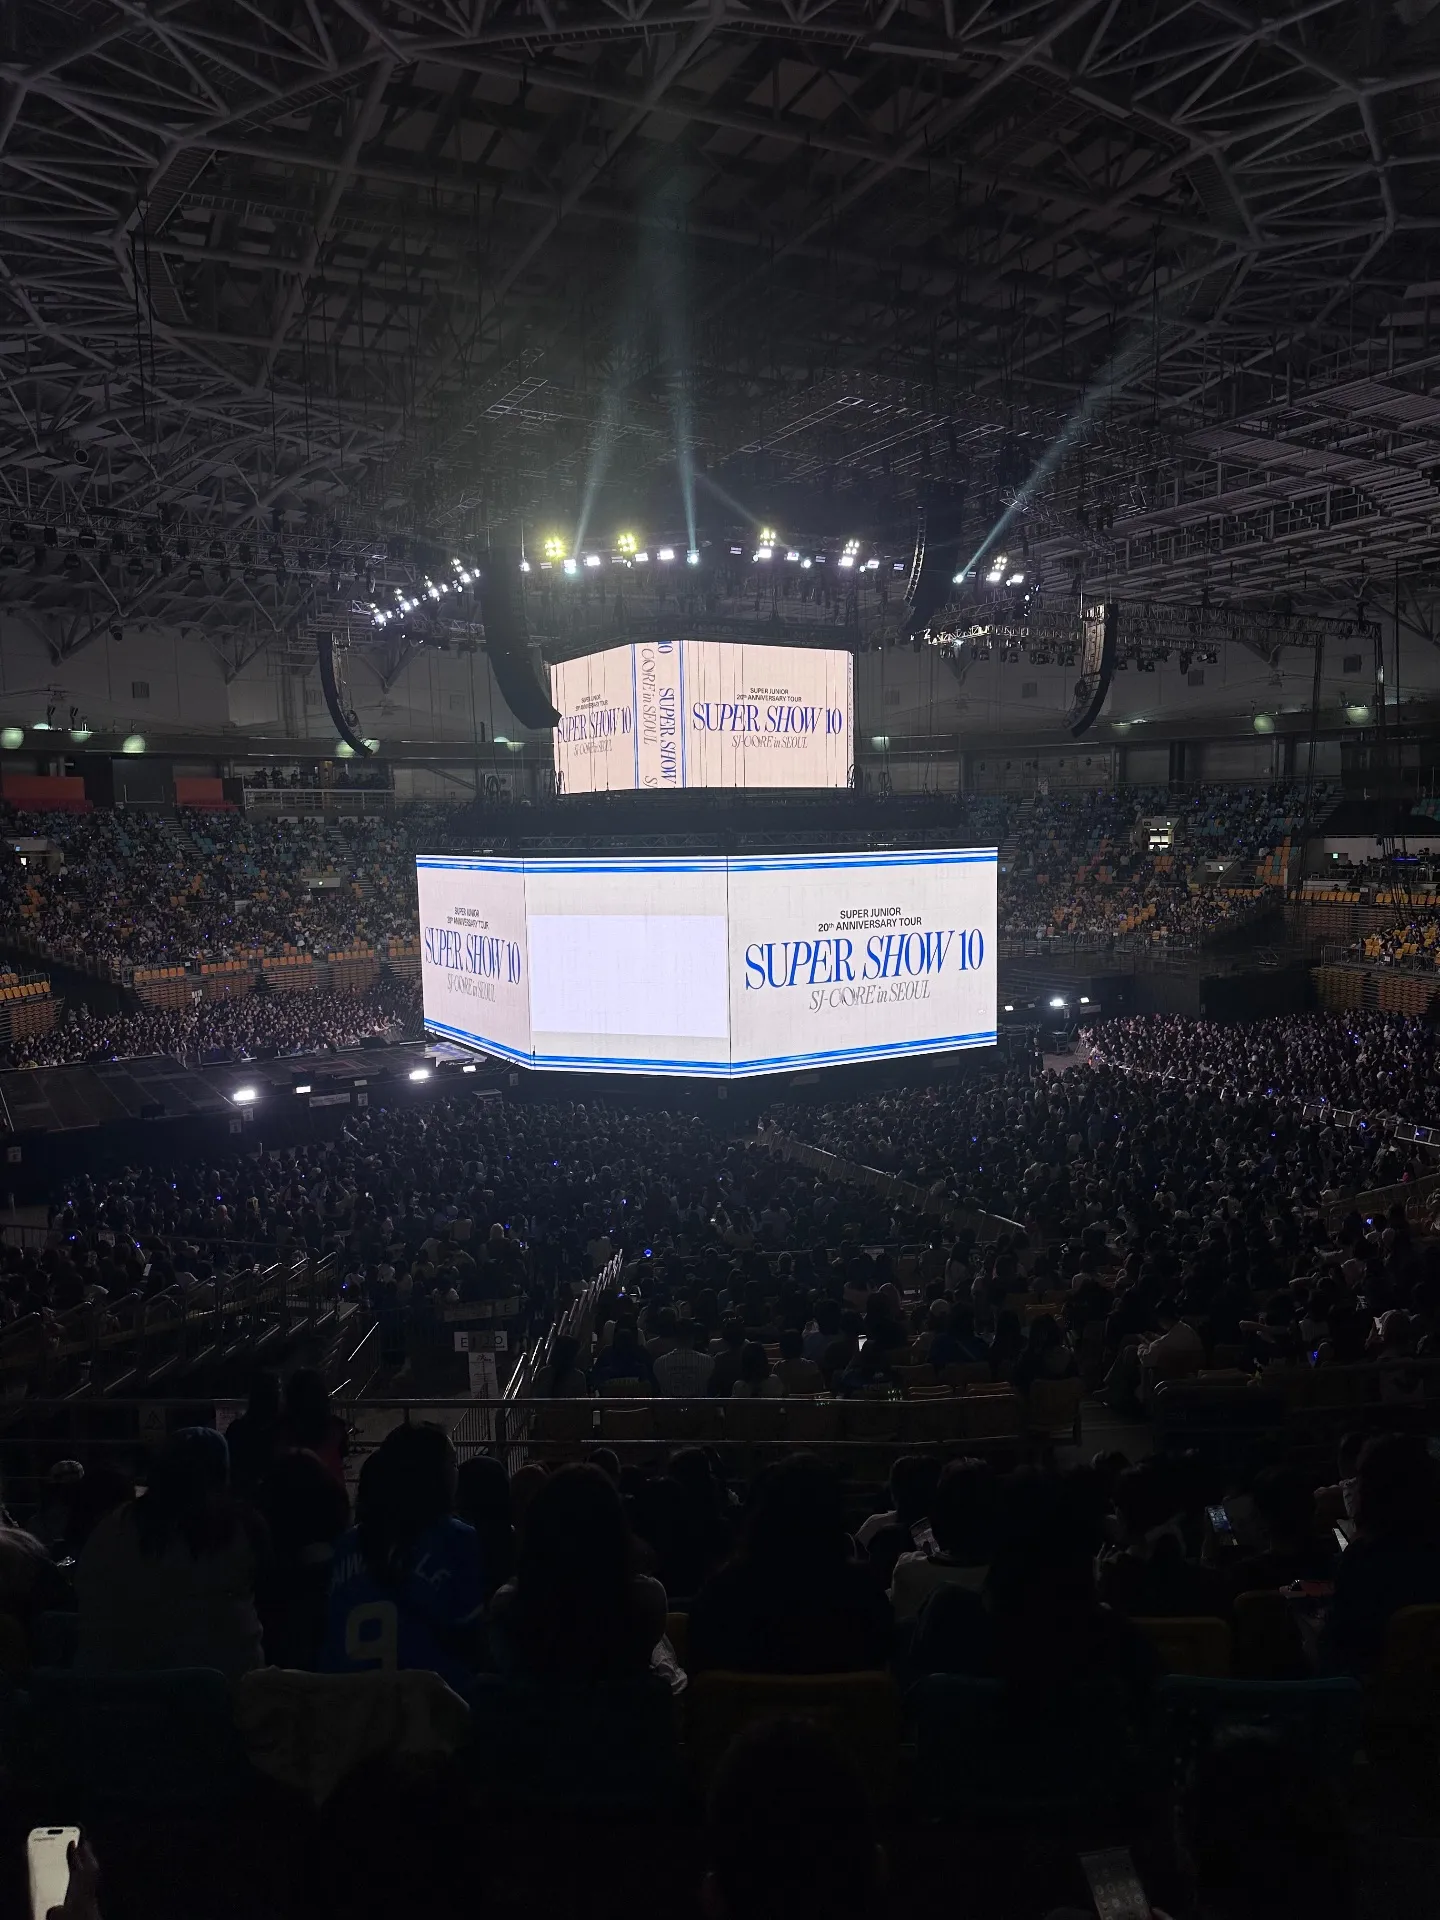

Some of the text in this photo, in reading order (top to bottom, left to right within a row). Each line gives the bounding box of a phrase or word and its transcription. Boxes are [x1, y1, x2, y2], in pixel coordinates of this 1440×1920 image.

[642, 693, 655, 703] in
[748, 694, 786, 702] ANNIVERSARY
[558, 706, 632, 744] SUPER SHOW 10
[642, 704, 658, 746] SEOUL
[658, 687, 677, 785] SUPER SHOW
[692, 702, 842, 735] SUPER SHOW 10
[774, 736, 780, 748] in
[781, 736, 808, 748] SEOUL
[818, 916, 922, 932] 20th ANNIVERSARY TOUR
[840, 906, 902, 920] SUPER JUNIOR
[424, 926, 521, 985] SUPER SHOW 10
[745, 928, 984, 991] SUPER SHOW 10
[809, 979, 931, 1014] SJ-CORE in SEOUL
[346, 1600, 398, 1671] 9
